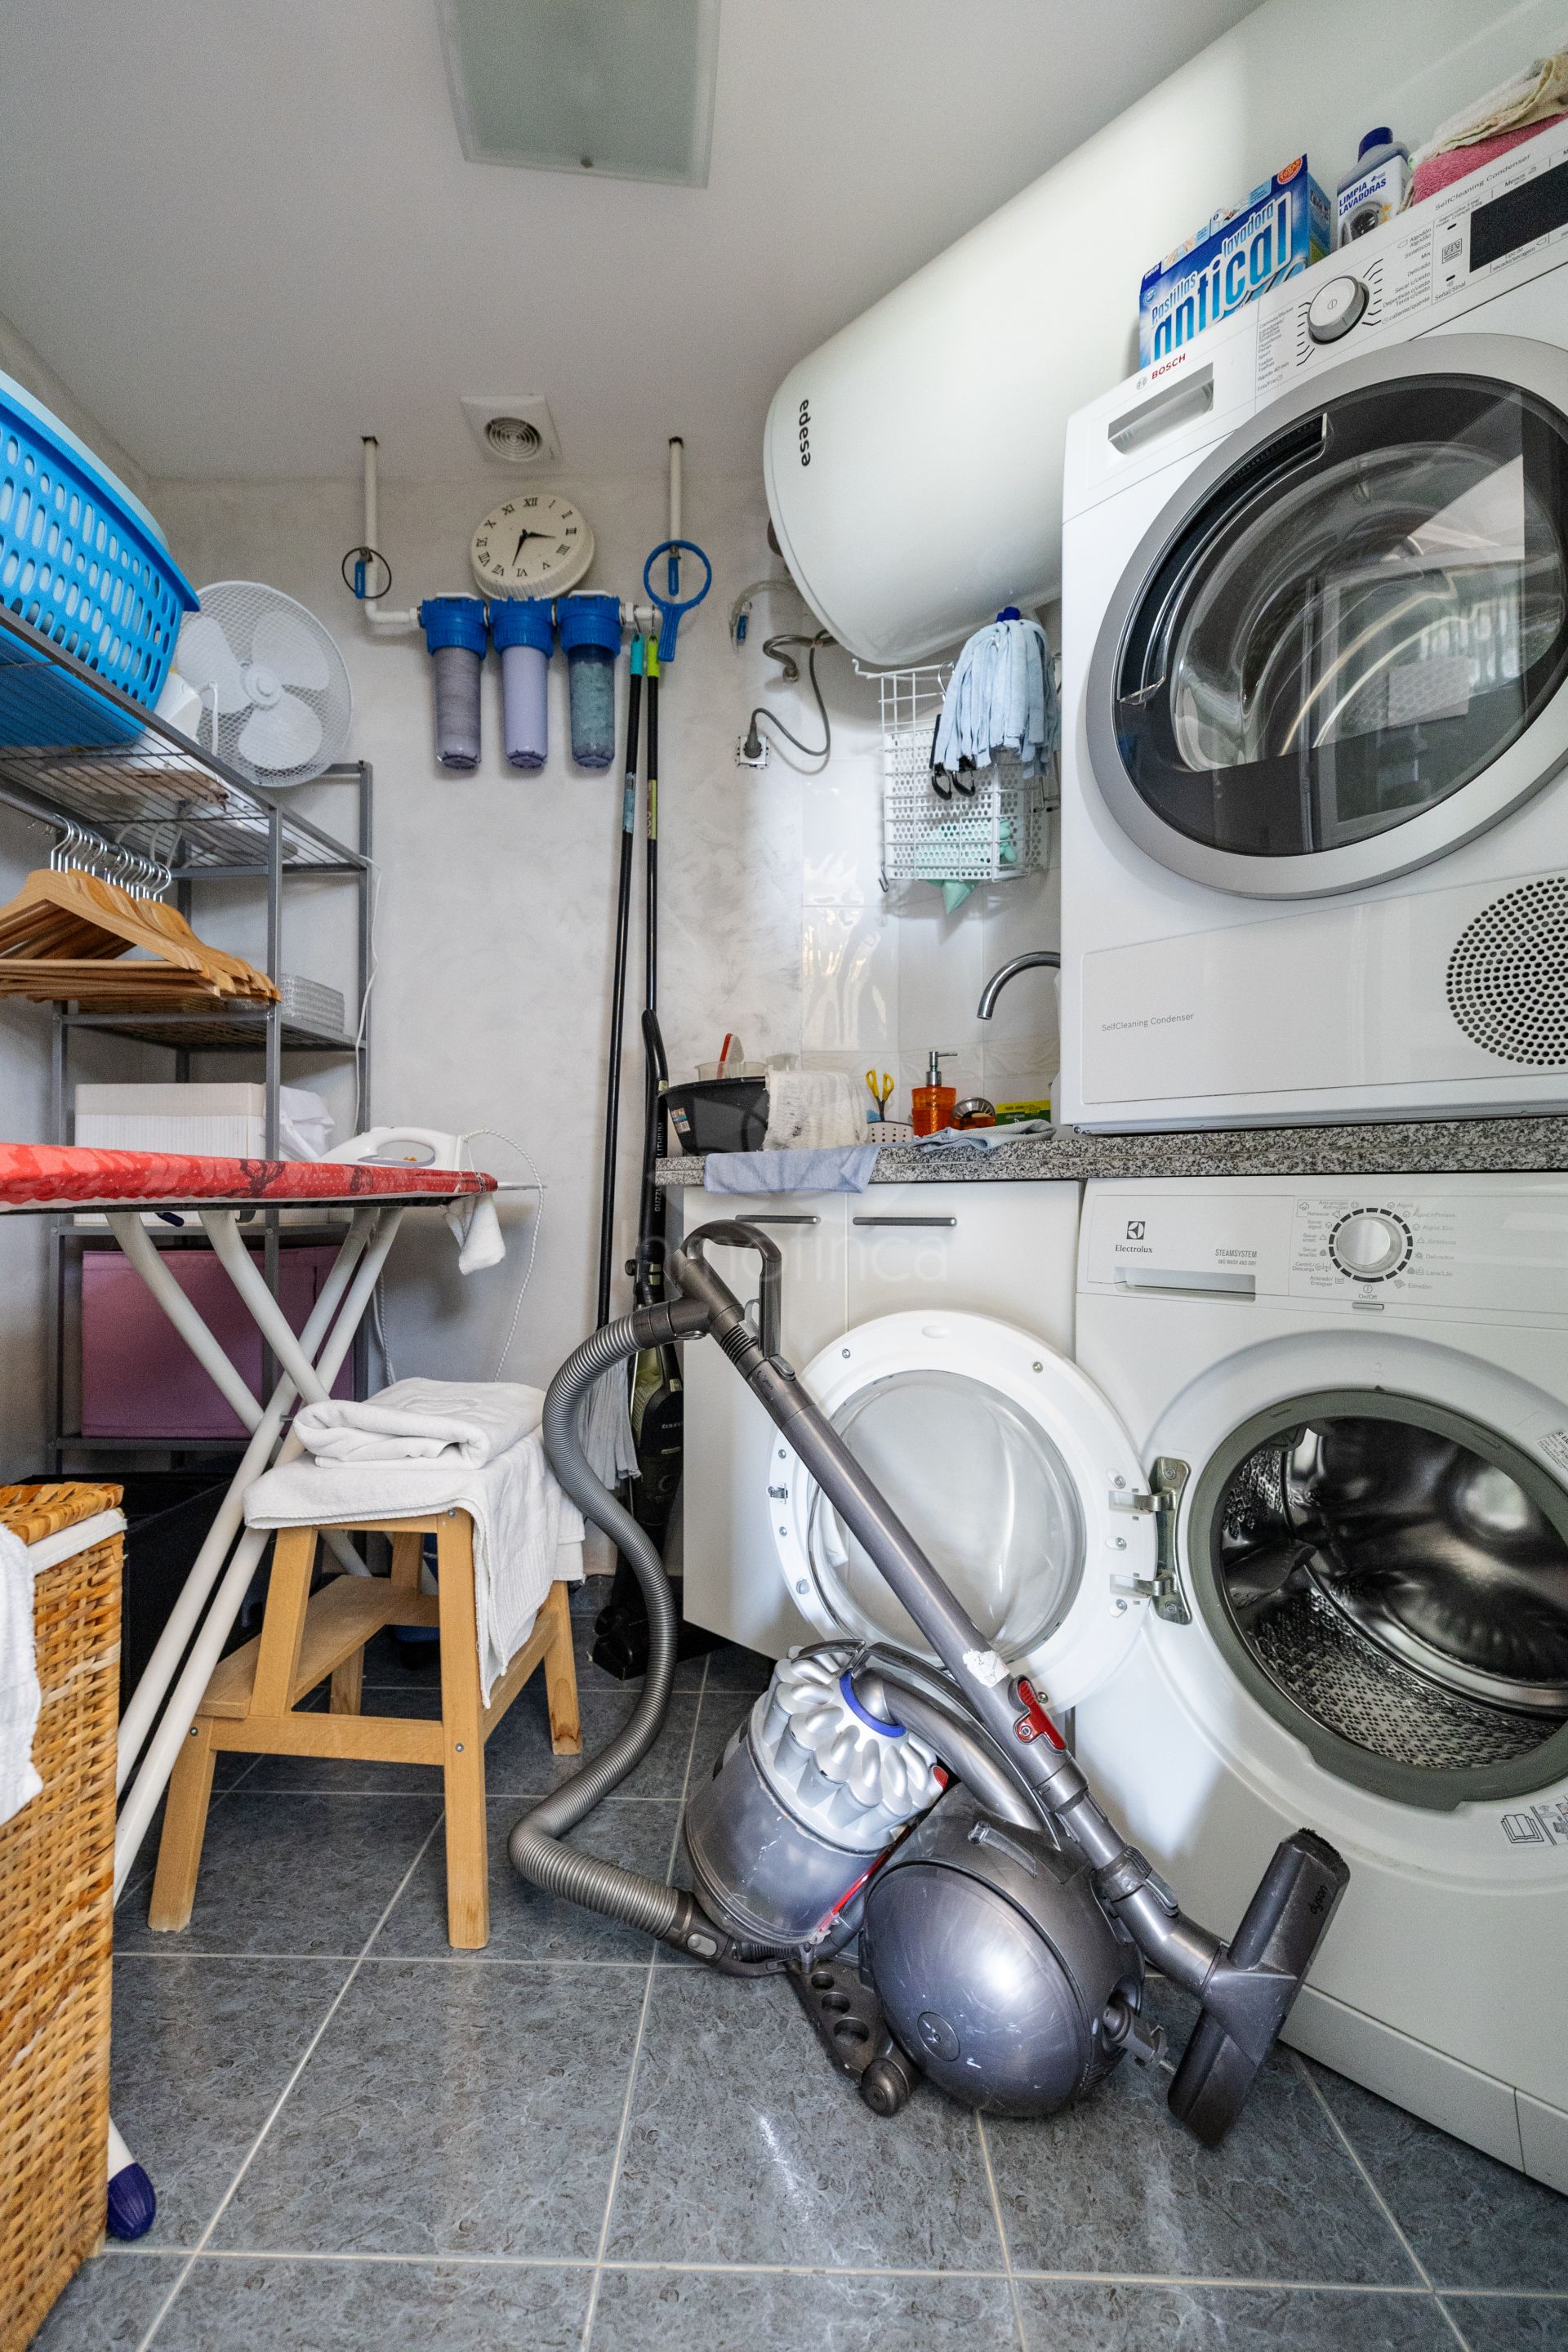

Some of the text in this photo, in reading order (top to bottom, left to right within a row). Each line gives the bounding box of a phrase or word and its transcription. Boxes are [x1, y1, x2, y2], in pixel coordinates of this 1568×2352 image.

[1339, 182, 1367, 207] LIMPIA
[1435, 154, 1530, 211] SelfCleaning Condenser
[1339, 178, 1387, 216] LAVADORAS
[1223, 201, 1274, 258] lavadora
[1152, 198, 1288, 362] antical
[1152, 274, 1196, 325] Pastillas
[1152, 353, 1186, 380] BOSCH
[799, 399, 812, 467] edesa
[501, 504, 515, 516] XI
[523, 497, 538, 507] XII
[548, 499, 556, 509] I
[484, 519, 497, 528] X
[541, 562, 551, 570] V
[1101, 1013, 1194, 1031] SelfCleaning Condenser
[1115, 1245, 1153, 1254] Electrolux
